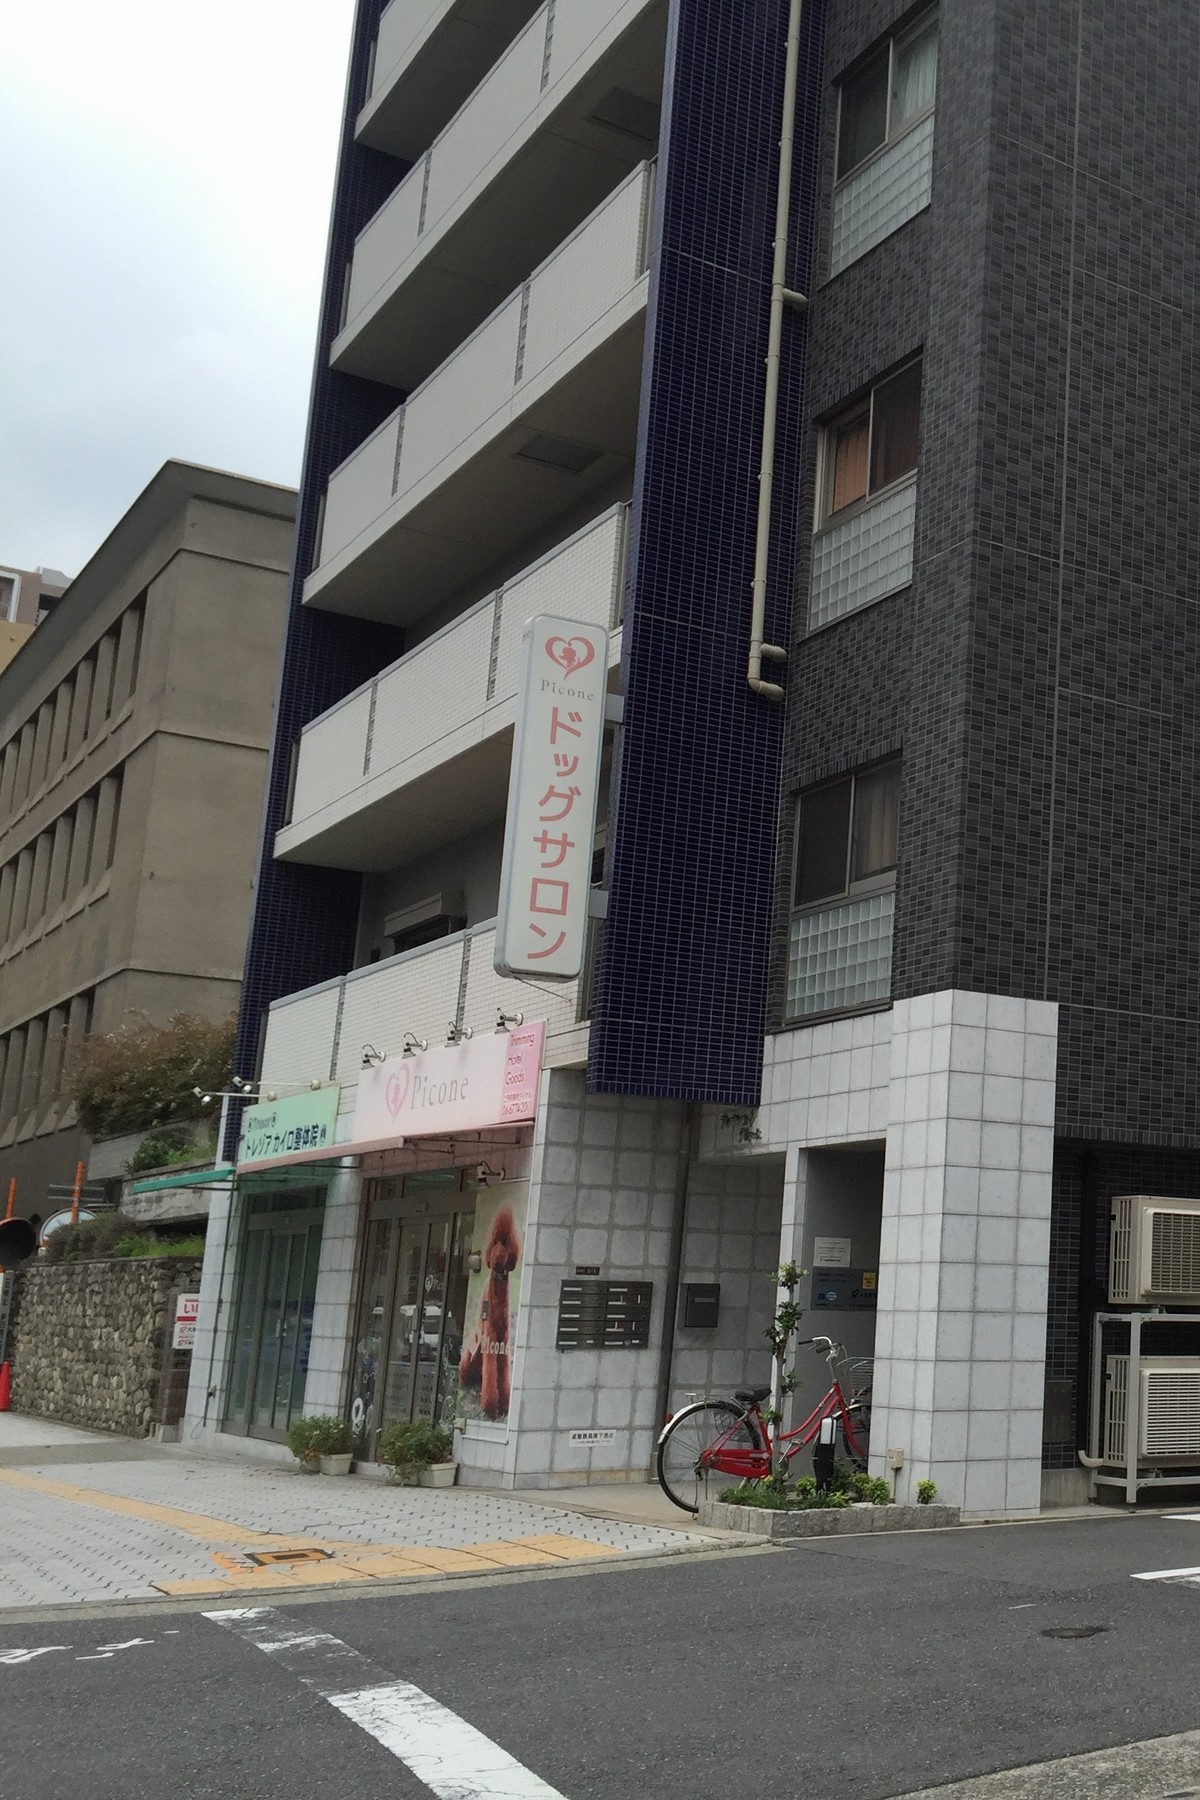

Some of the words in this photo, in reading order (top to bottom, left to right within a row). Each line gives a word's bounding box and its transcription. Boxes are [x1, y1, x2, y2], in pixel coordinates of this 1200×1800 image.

[540, 679, 595, 701] Picone
[527, 705, 583, 960] ドッグサロン
[506, 1068, 525, 1085] Goods
[410, 1074, 469, 1110] Picone
